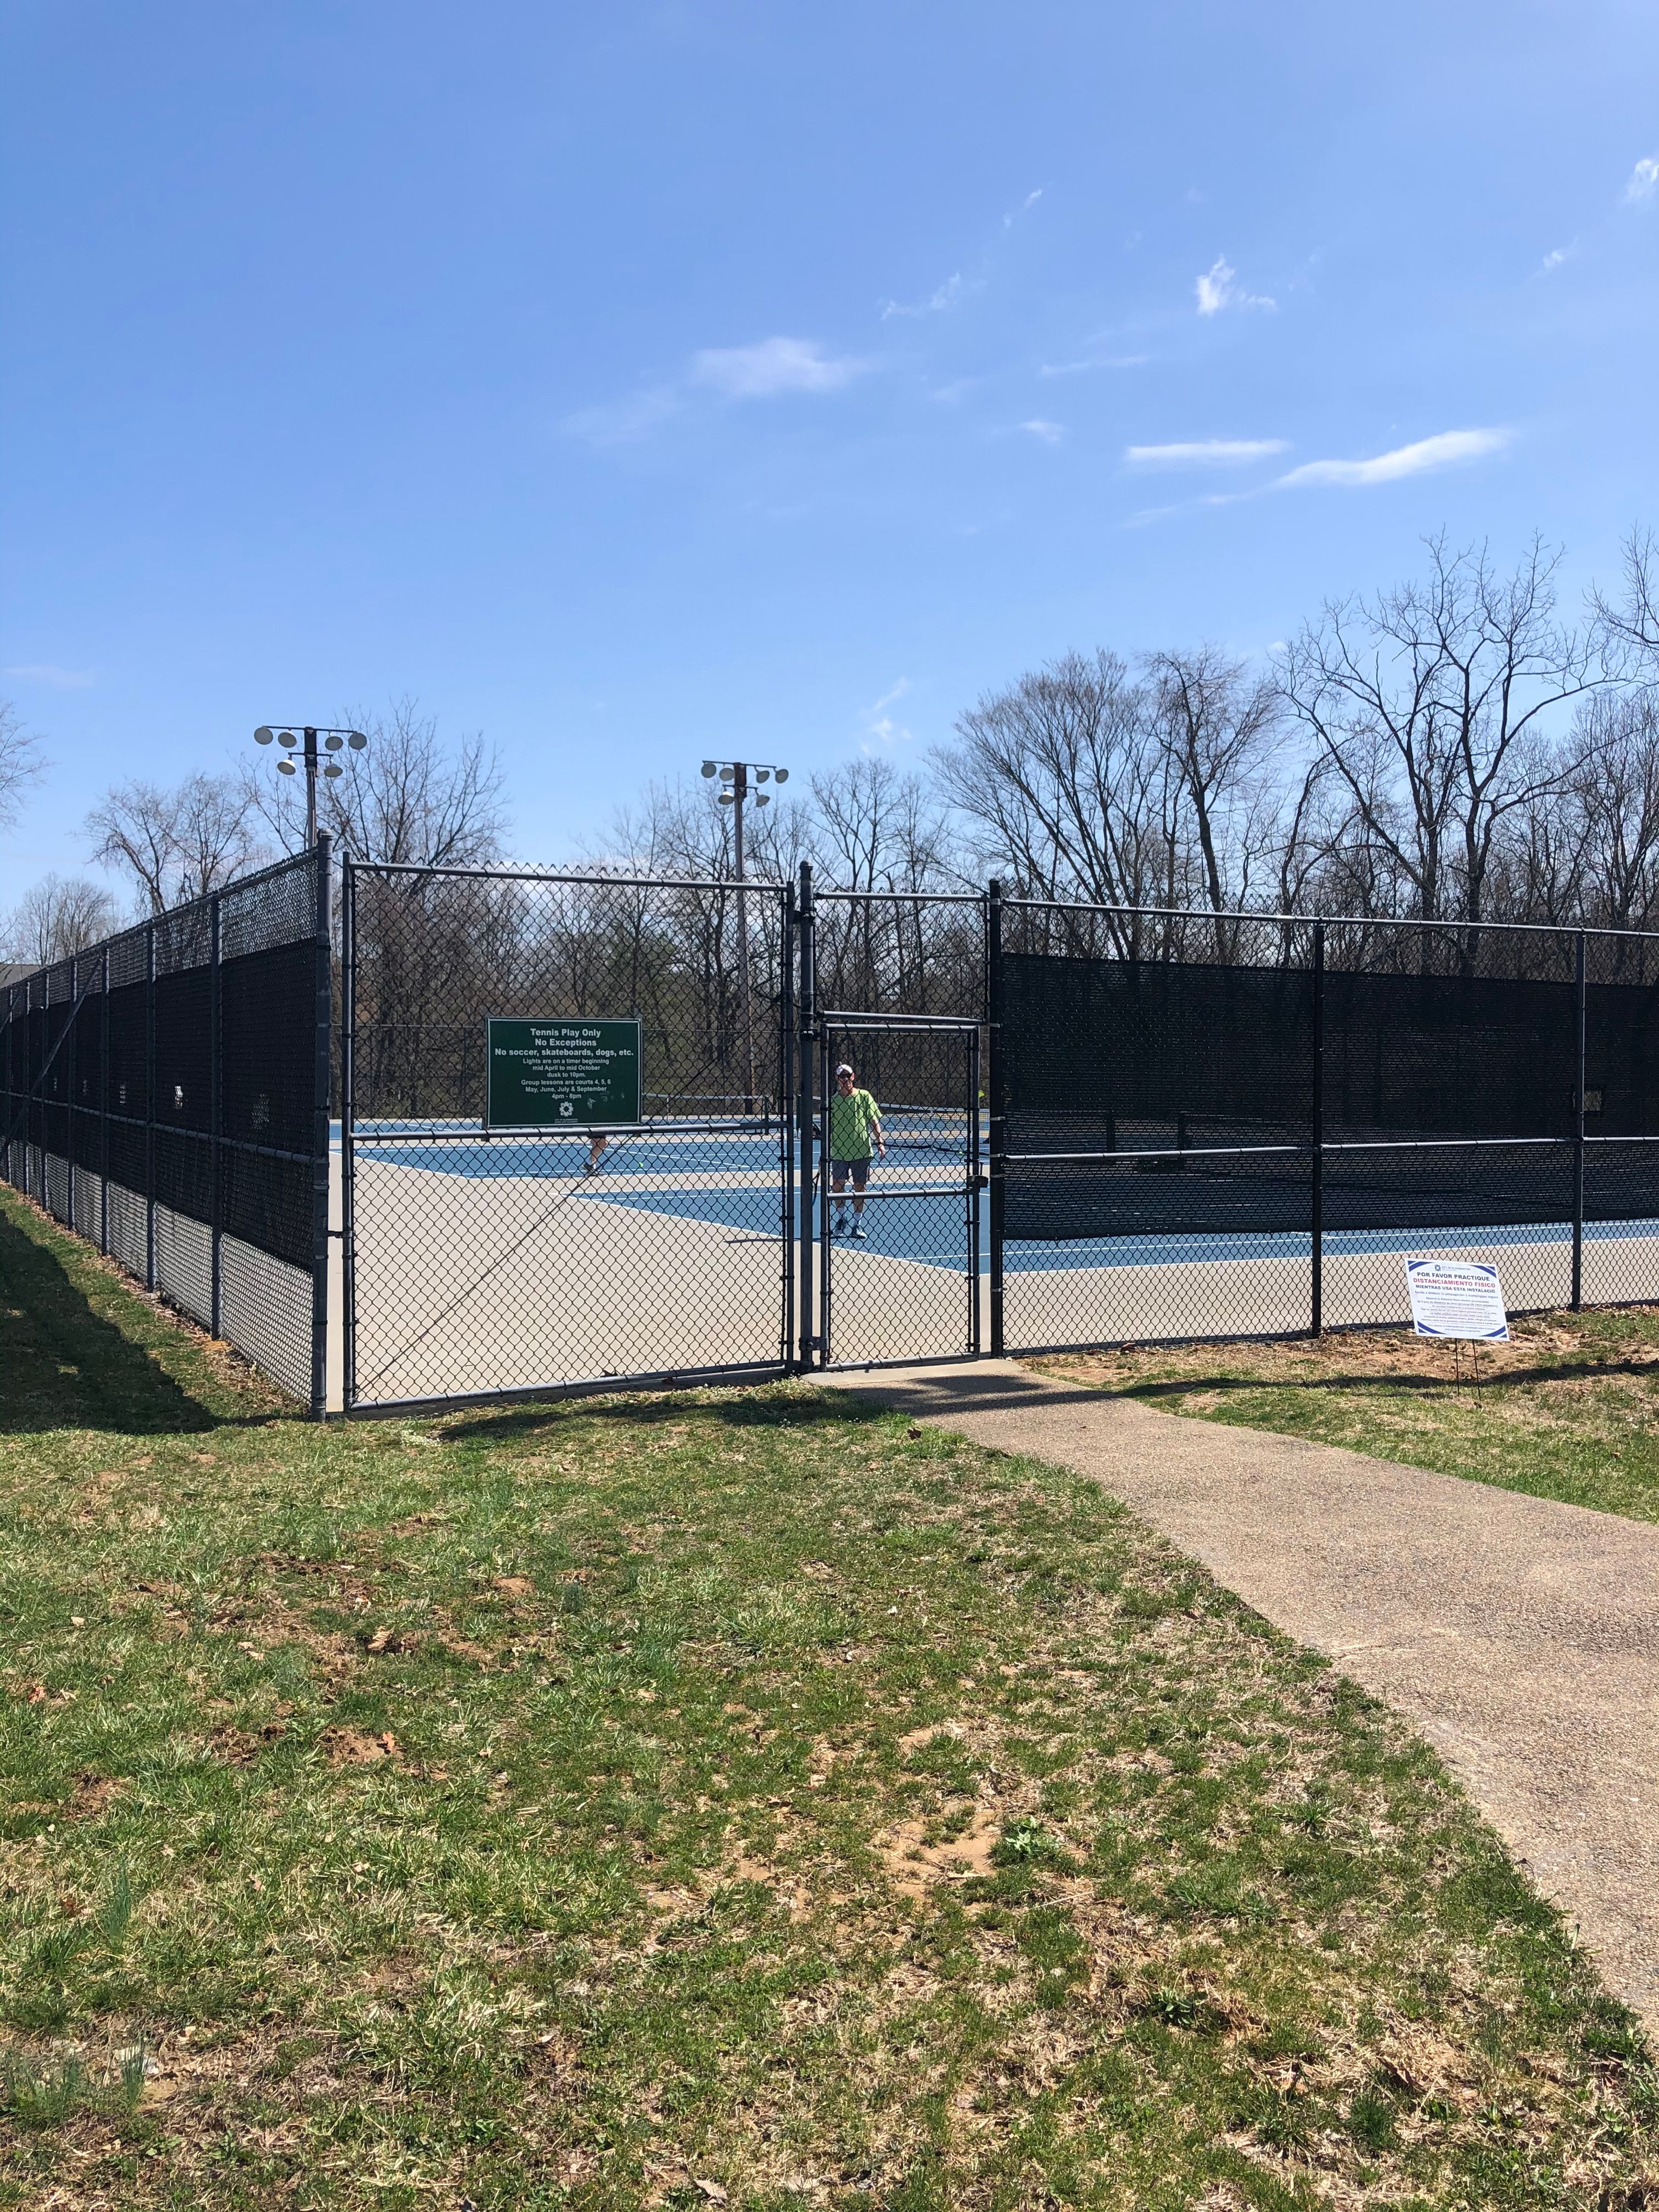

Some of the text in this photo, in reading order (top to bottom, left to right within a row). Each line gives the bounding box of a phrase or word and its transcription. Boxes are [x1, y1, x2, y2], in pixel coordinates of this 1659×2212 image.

[562, 1029, 579, 1037] Play
[582, 1029, 601, 1038] Only
[550, 1039, 597, 1047] Exceptions
[542, 1049, 594, 1057] skateboards,
[596, 1049, 617, 1057] dogs,
[1413, 1278, 1472, 1286] DISTANCIAMIENTO
